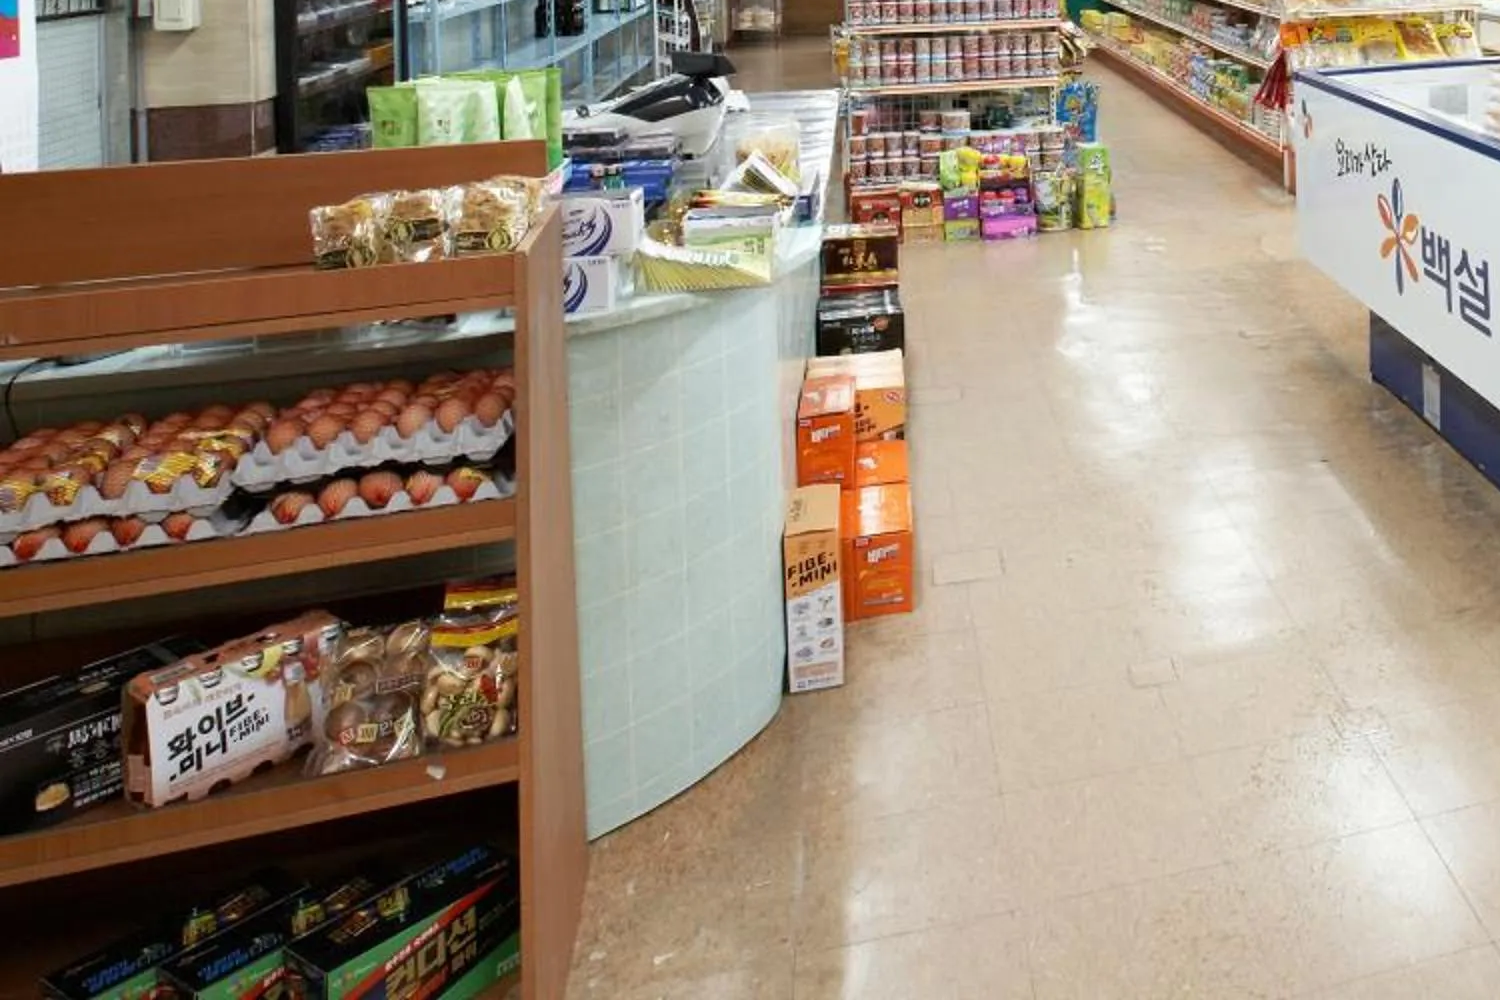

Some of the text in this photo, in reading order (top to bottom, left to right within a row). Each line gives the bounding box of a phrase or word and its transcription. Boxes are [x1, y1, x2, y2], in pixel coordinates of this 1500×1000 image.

[1334, 140, 1393, 177] 요리가 산다
[1421, 226, 1493, 338] 백설
